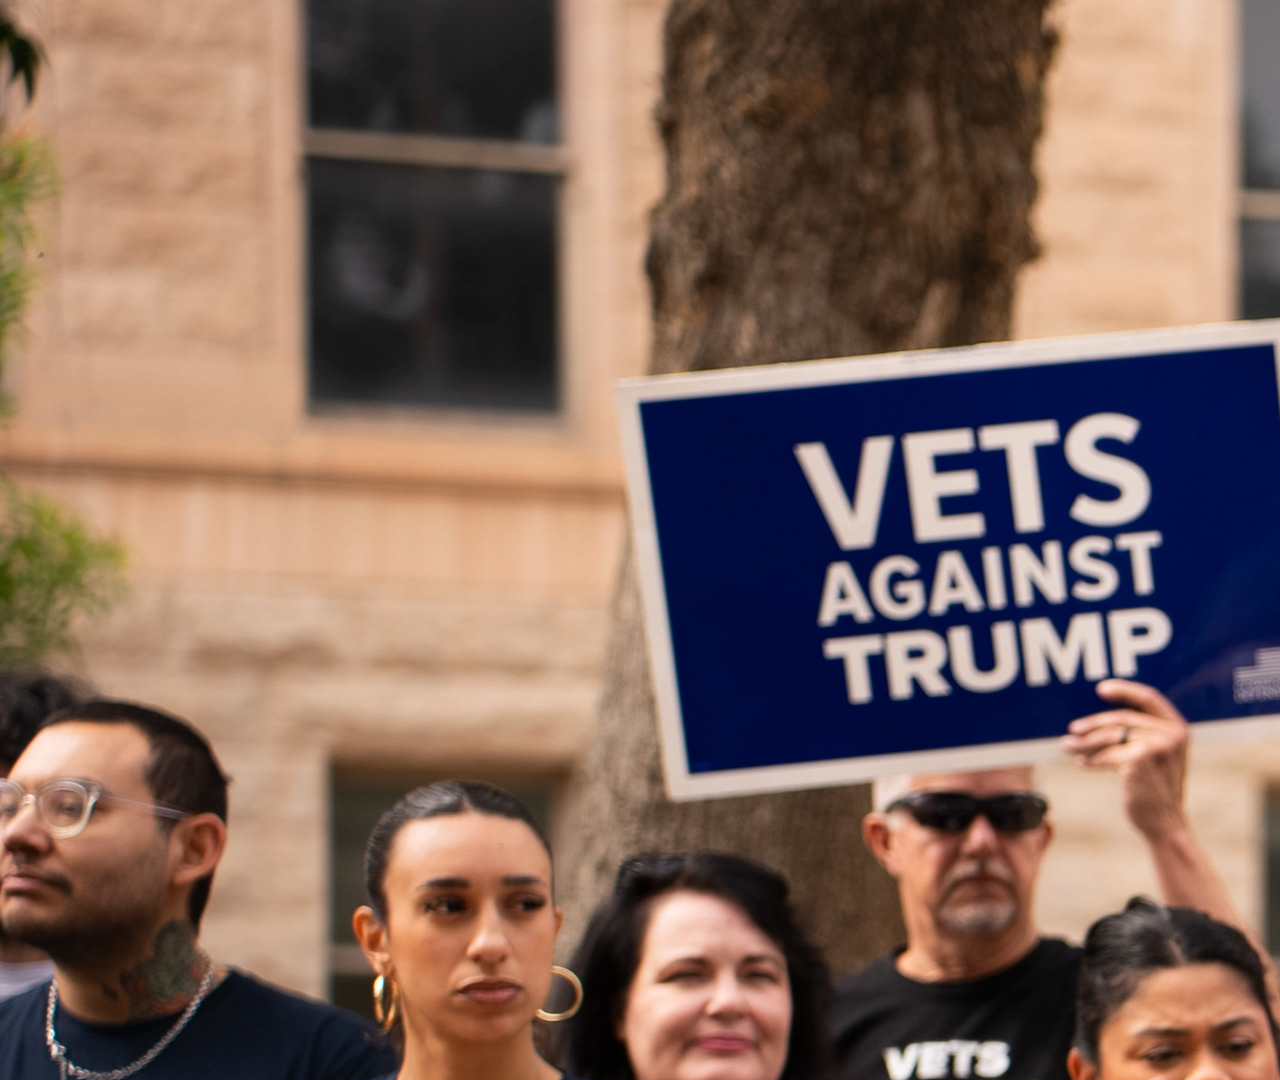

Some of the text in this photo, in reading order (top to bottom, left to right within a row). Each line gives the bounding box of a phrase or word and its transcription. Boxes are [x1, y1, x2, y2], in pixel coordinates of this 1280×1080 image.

[793, 412, 1152, 551] VETS
[817, 531, 1162, 627] AGAINST
[822, 607, 1173, 704] TRUMP
